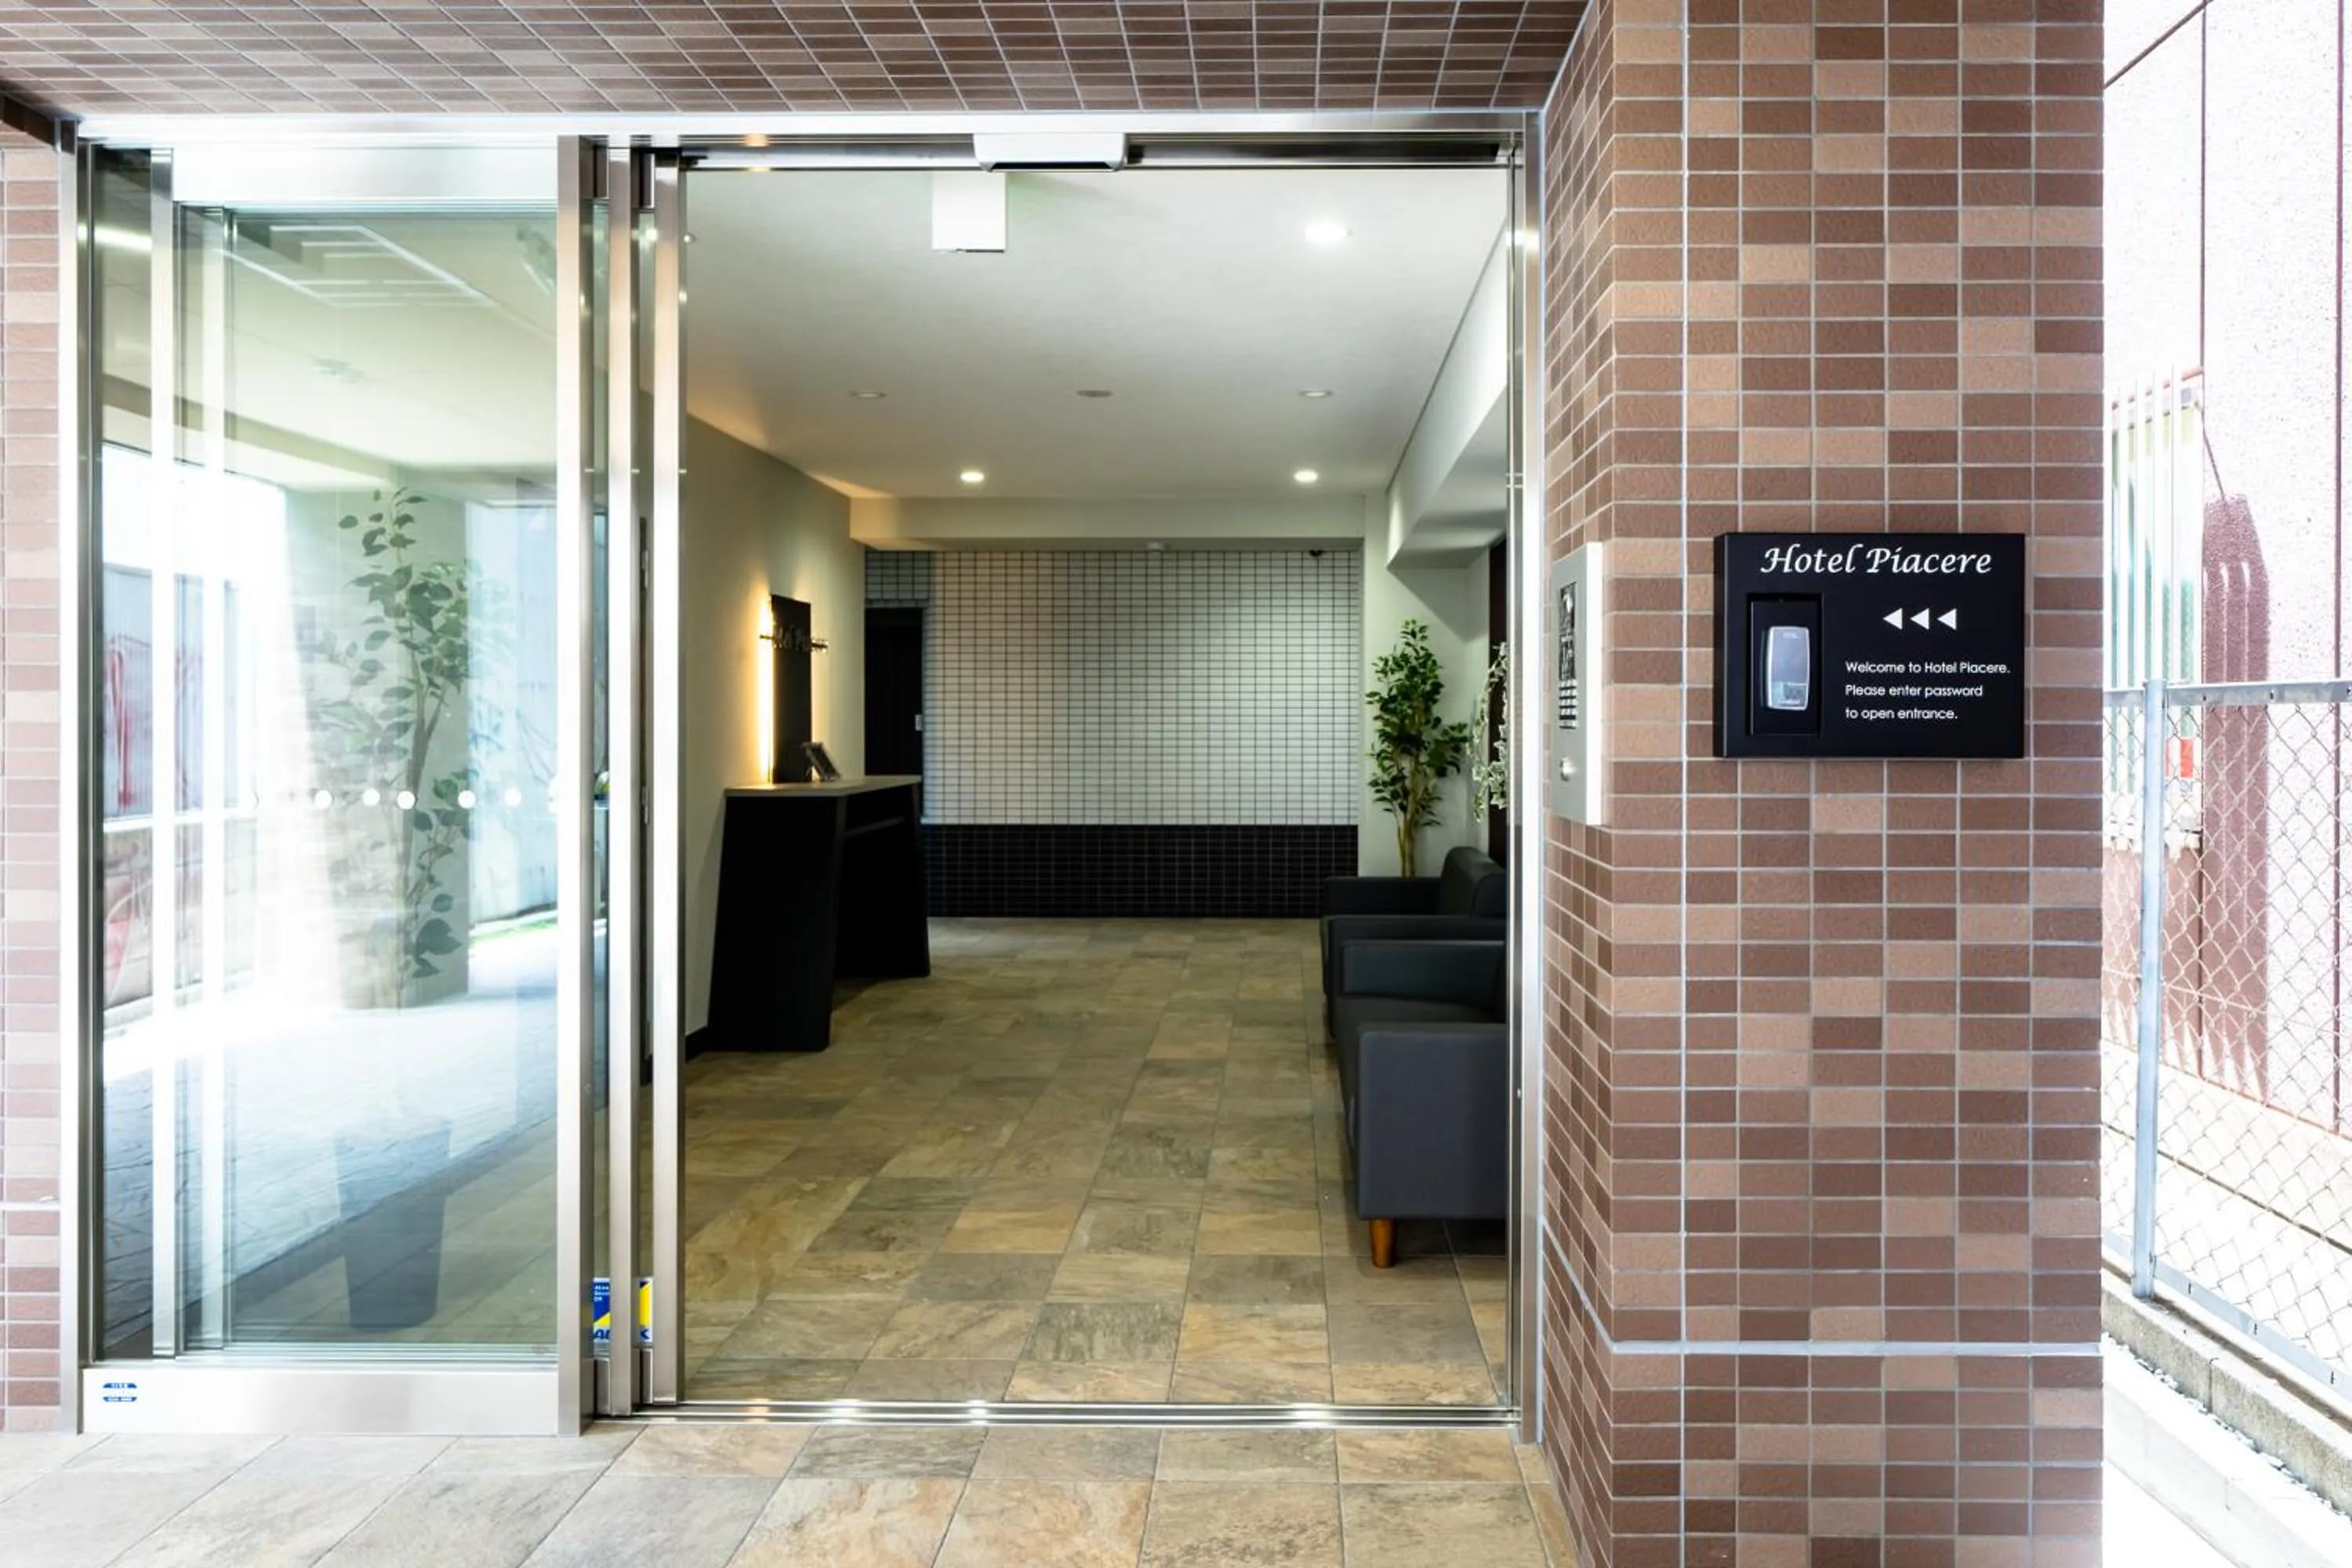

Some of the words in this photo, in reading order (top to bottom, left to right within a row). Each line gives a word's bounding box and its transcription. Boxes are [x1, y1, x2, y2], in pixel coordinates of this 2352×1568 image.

[1759, 543, 1864, 574] Hotel
[1865, 546, 1992, 574] Piacere
[1845, 661, 1906, 673] Welcome
[1907, 661, 1922, 673] to
[1924, 661, 1958, 673] Hotel
[1959, 661, 2011, 673] Piacere.
[1845, 684, 1886, 696] Please
[1889, 684, 1922, 696] enter
[1924, 684, 1984, 699] password
[1845, 707, 1859, 719] to
[1860, 710, 1895, 720] open
[1896, 708, 1958, 720] entrance.
